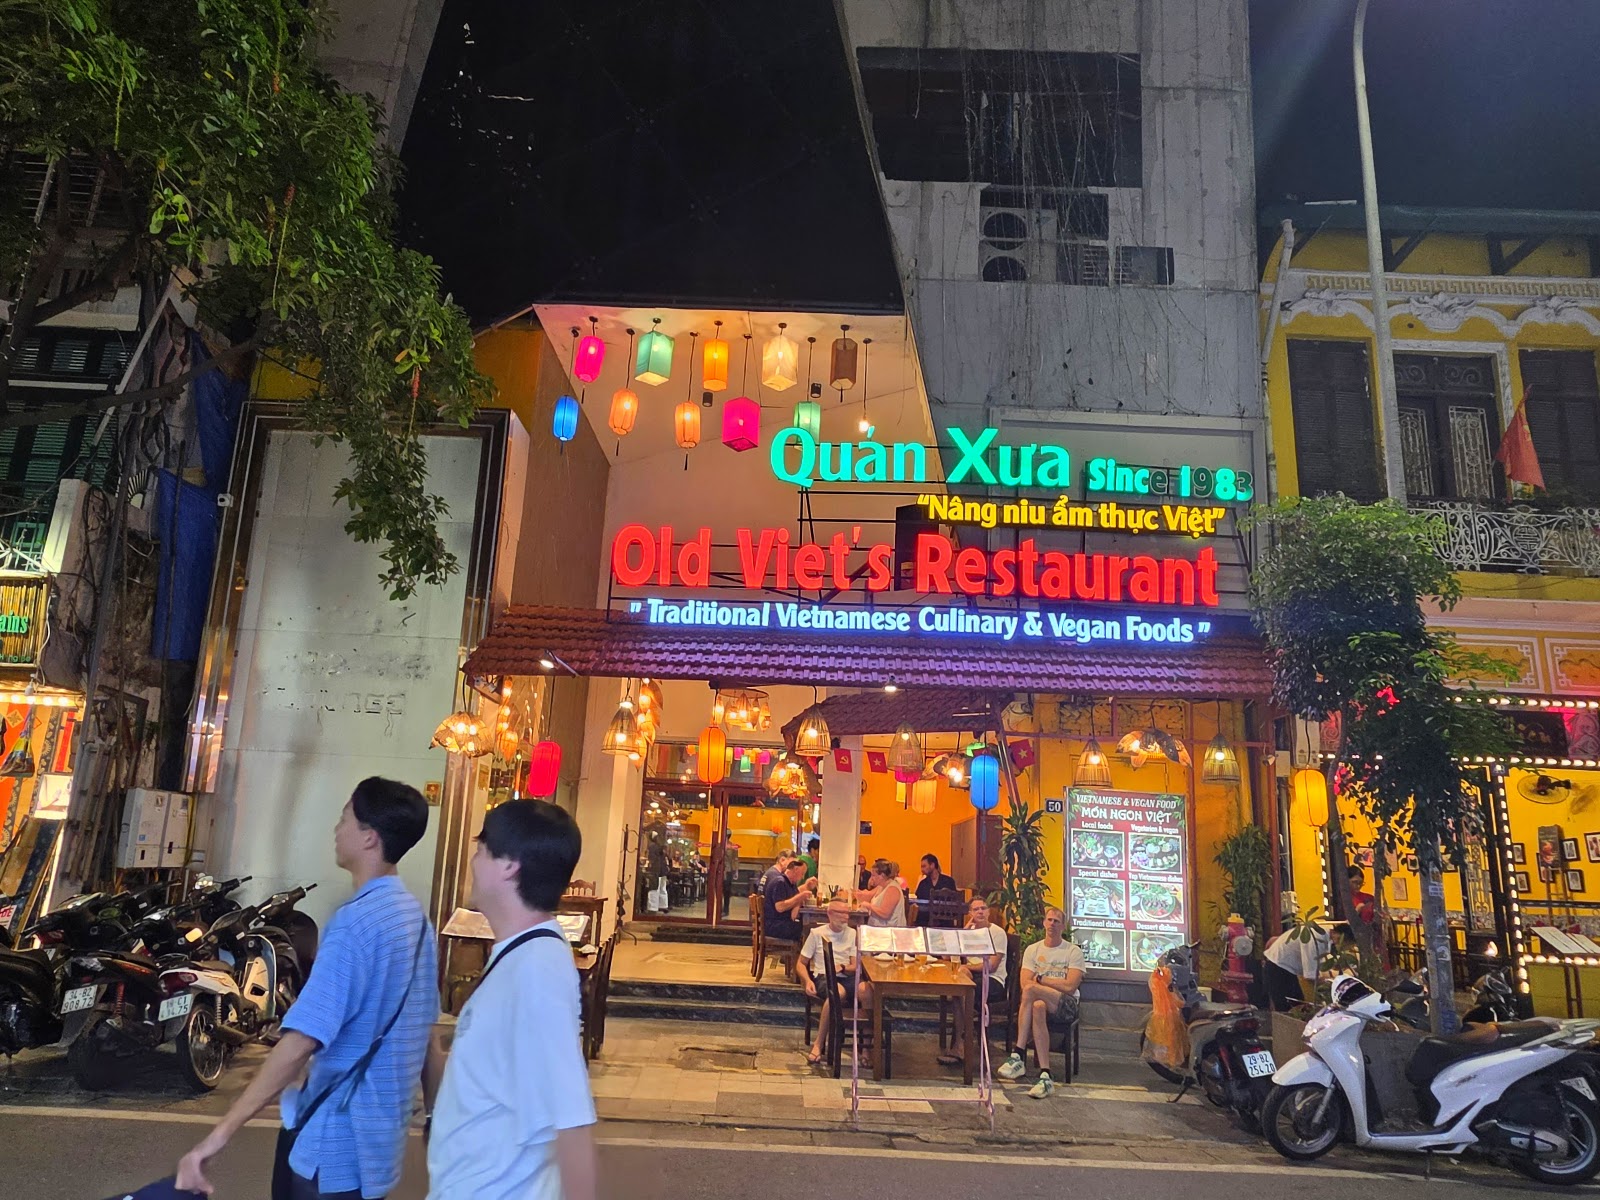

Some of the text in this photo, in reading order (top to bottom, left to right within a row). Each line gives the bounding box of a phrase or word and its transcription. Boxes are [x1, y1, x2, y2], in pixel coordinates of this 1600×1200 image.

[770, 426, 1254, 501] Quán Xưa Since 1983
[1003, 498, 1046, 525] niu
[1052, 495, 1093, 527] ẩm
[1098, 503, 1159, 534] thực
[613, 525, 1219, 606] Old Viet's Restaurant
[648, 598, 770, 627] Traditional
[776, 602, 911, 632] Vietnamese
[918, 607, 1018, 640] Culinary
[1024, 611, 1043, 637] &
[1048, 613, 1121, 644] Vegan
[1126, 615, 1194, 643] Foods
[1048, 801, 1062, 812] 50
[1076, 794, 1177, 809] VIETNAMESE & VEGAN FOOD
[1081, 806, 1172, 825] MÓN NGON VIỆT
[1081, 821, 1114, 830] Local foods
[1130, 823, 1158, 833] Vegetarian
[1078, 869, 1118, 879] Special dishes
[1128, 873, 1183, 883] Top Vietnamese dishes
[1073, 918, 1125, 928] Traditional dishes
[1136, 922, 1178, 932] Dessert dishes
[63, 997, 93, 1012] 908.72
[1249, 1062, 1275, 1077] 254.20
